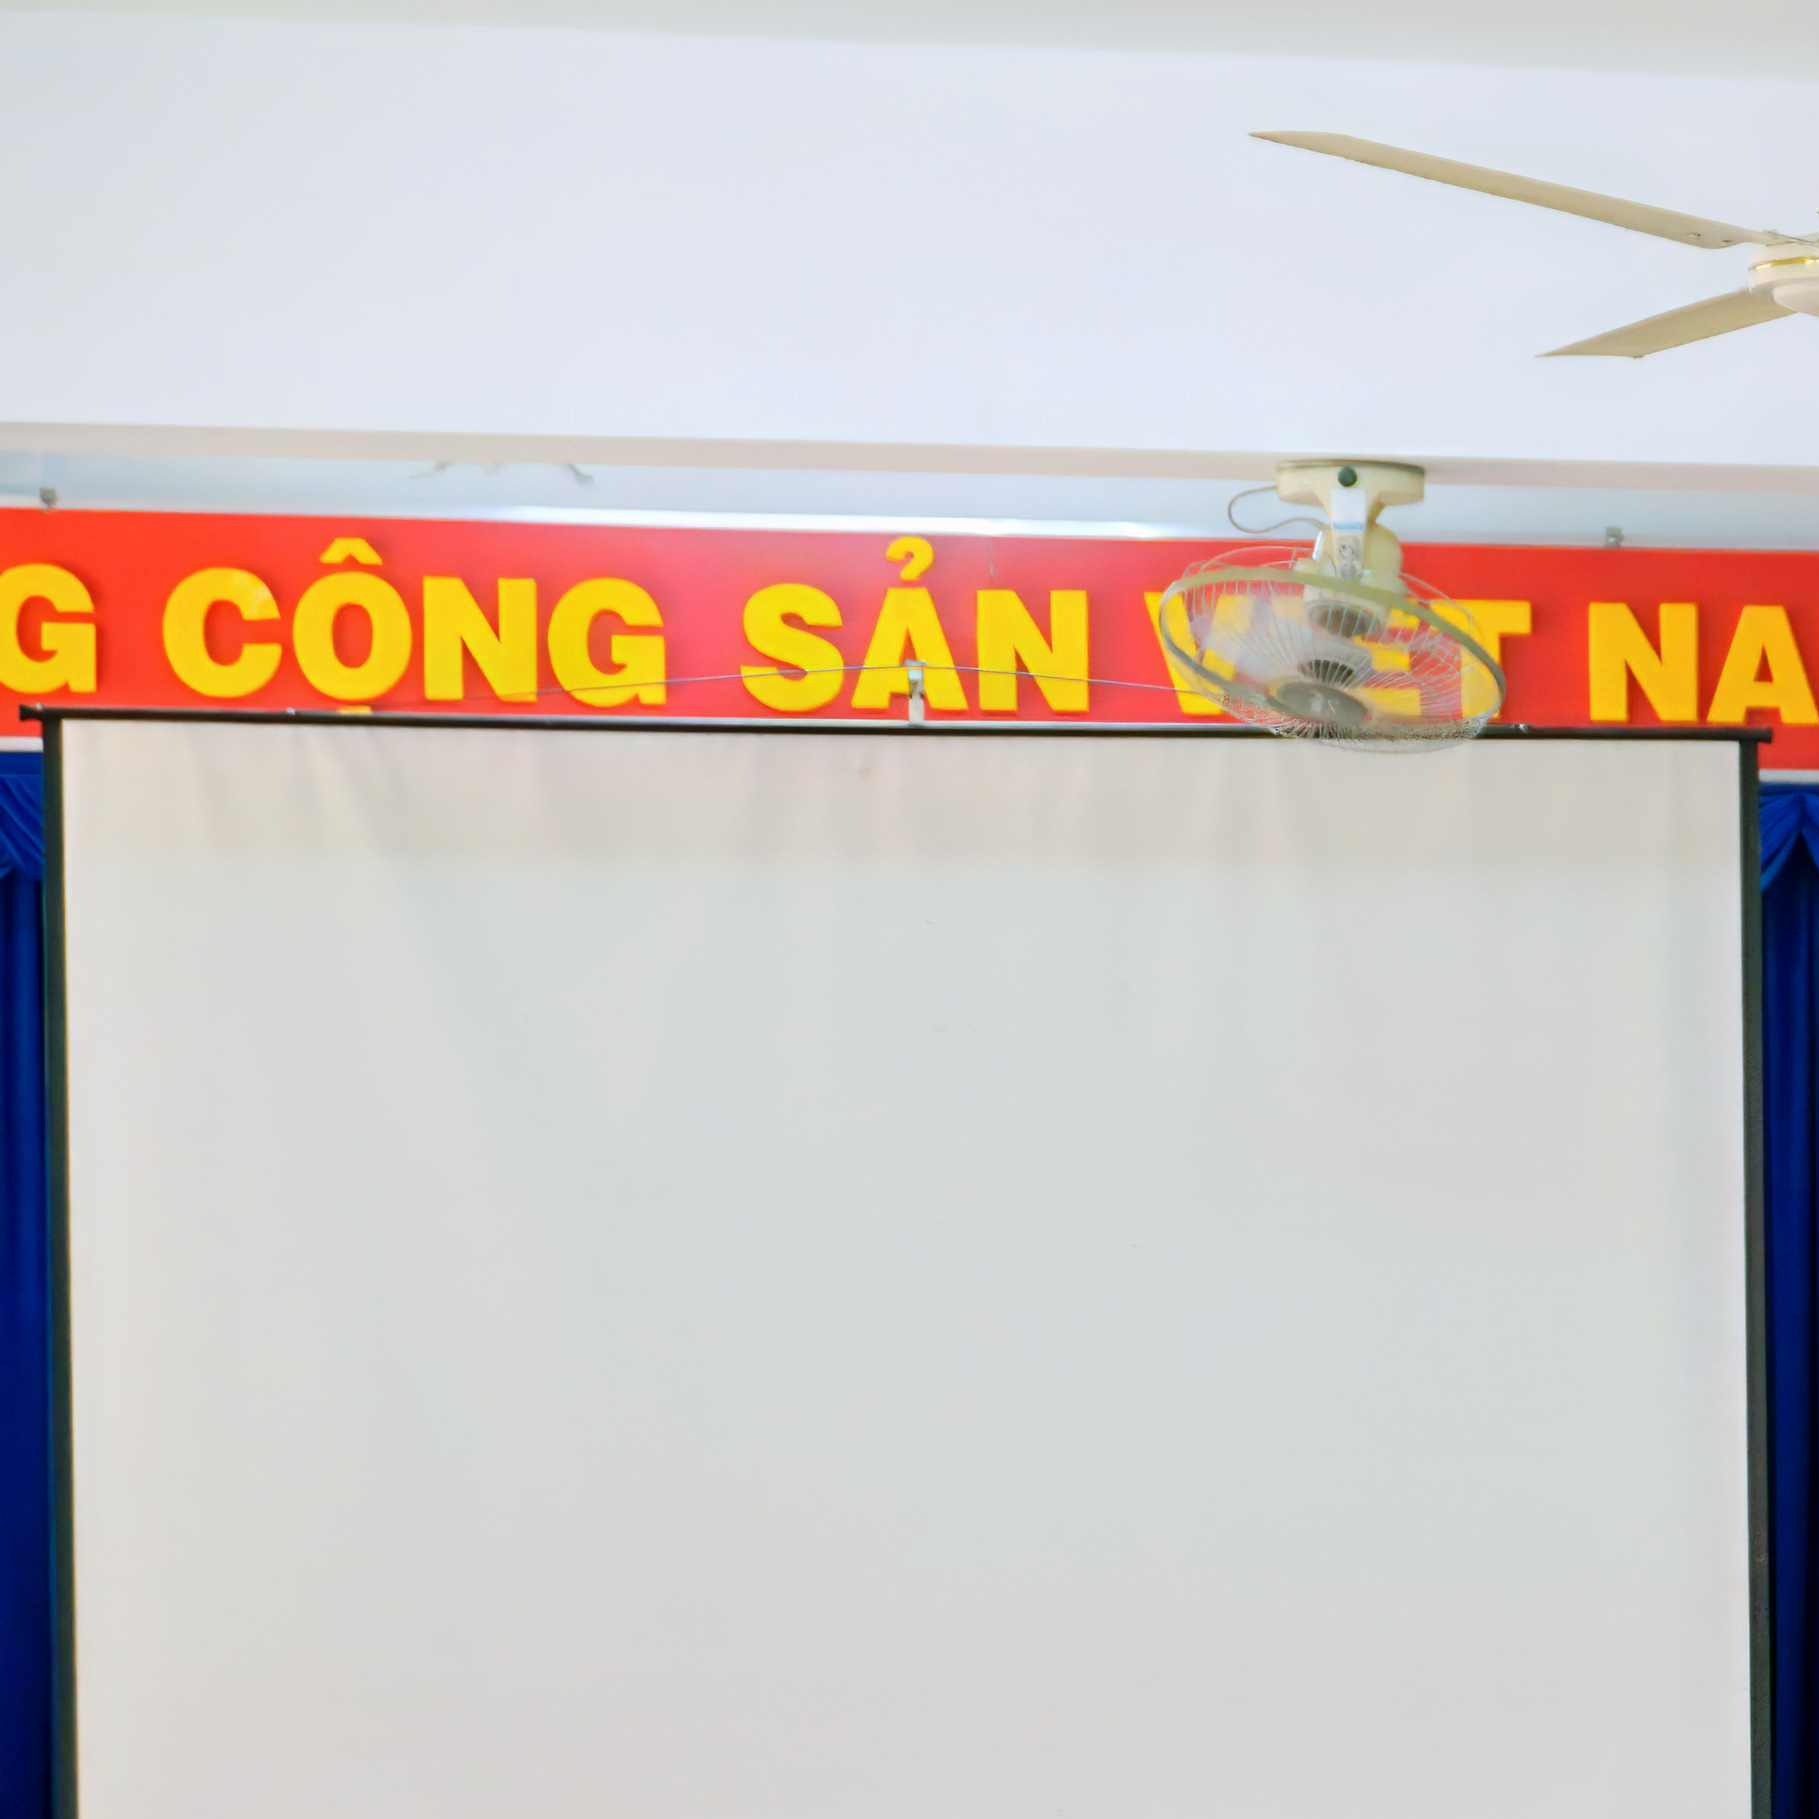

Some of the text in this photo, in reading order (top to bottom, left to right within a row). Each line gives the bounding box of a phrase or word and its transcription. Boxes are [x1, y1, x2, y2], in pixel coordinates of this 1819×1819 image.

[163, 538, 668, 707] CÔNG
[741, 538, 1090, 712] SẢN
[1144, 588, 1533, 719] VT
